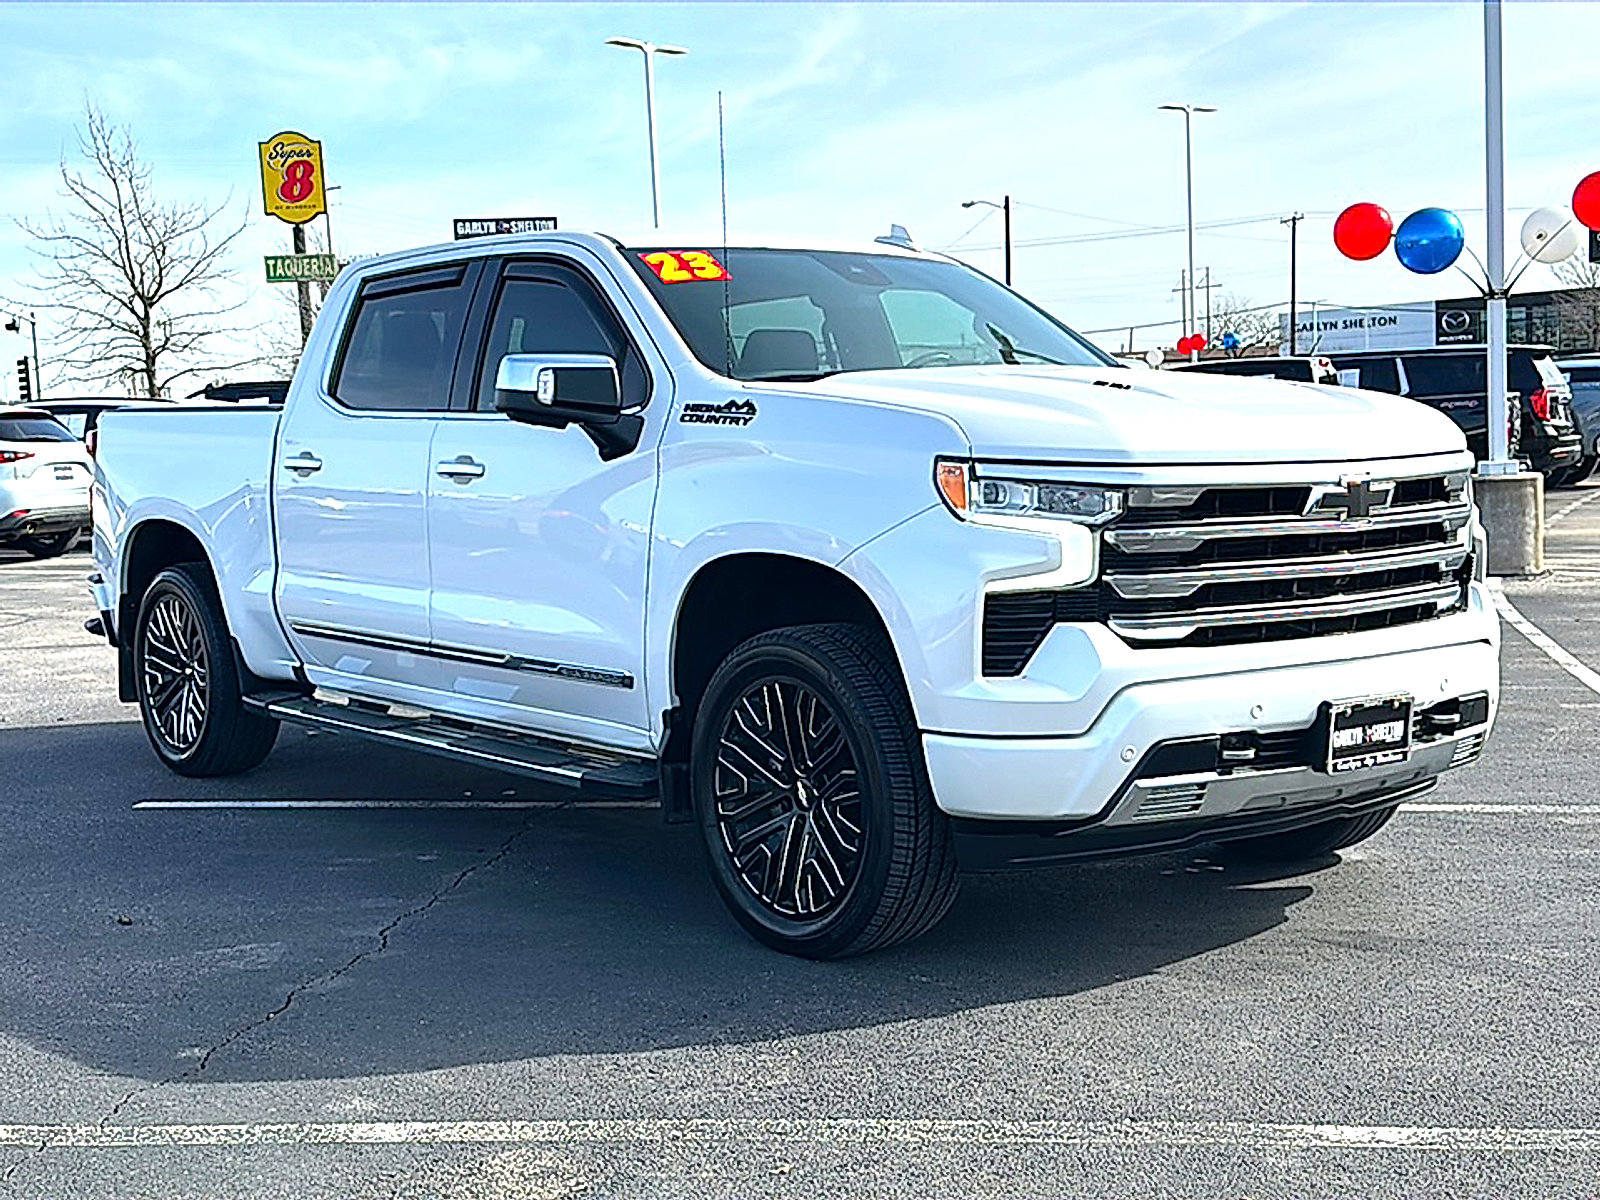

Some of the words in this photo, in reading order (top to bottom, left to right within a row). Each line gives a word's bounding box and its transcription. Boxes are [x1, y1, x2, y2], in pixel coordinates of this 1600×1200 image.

[268, 141, 313, 167] Super
[279, 160, 315, 203] 8
[509, 219, 555, 234] SHELTON
[266, 257, 334, 278] TAQUERIA
[645, 252, 722, 281] 23
